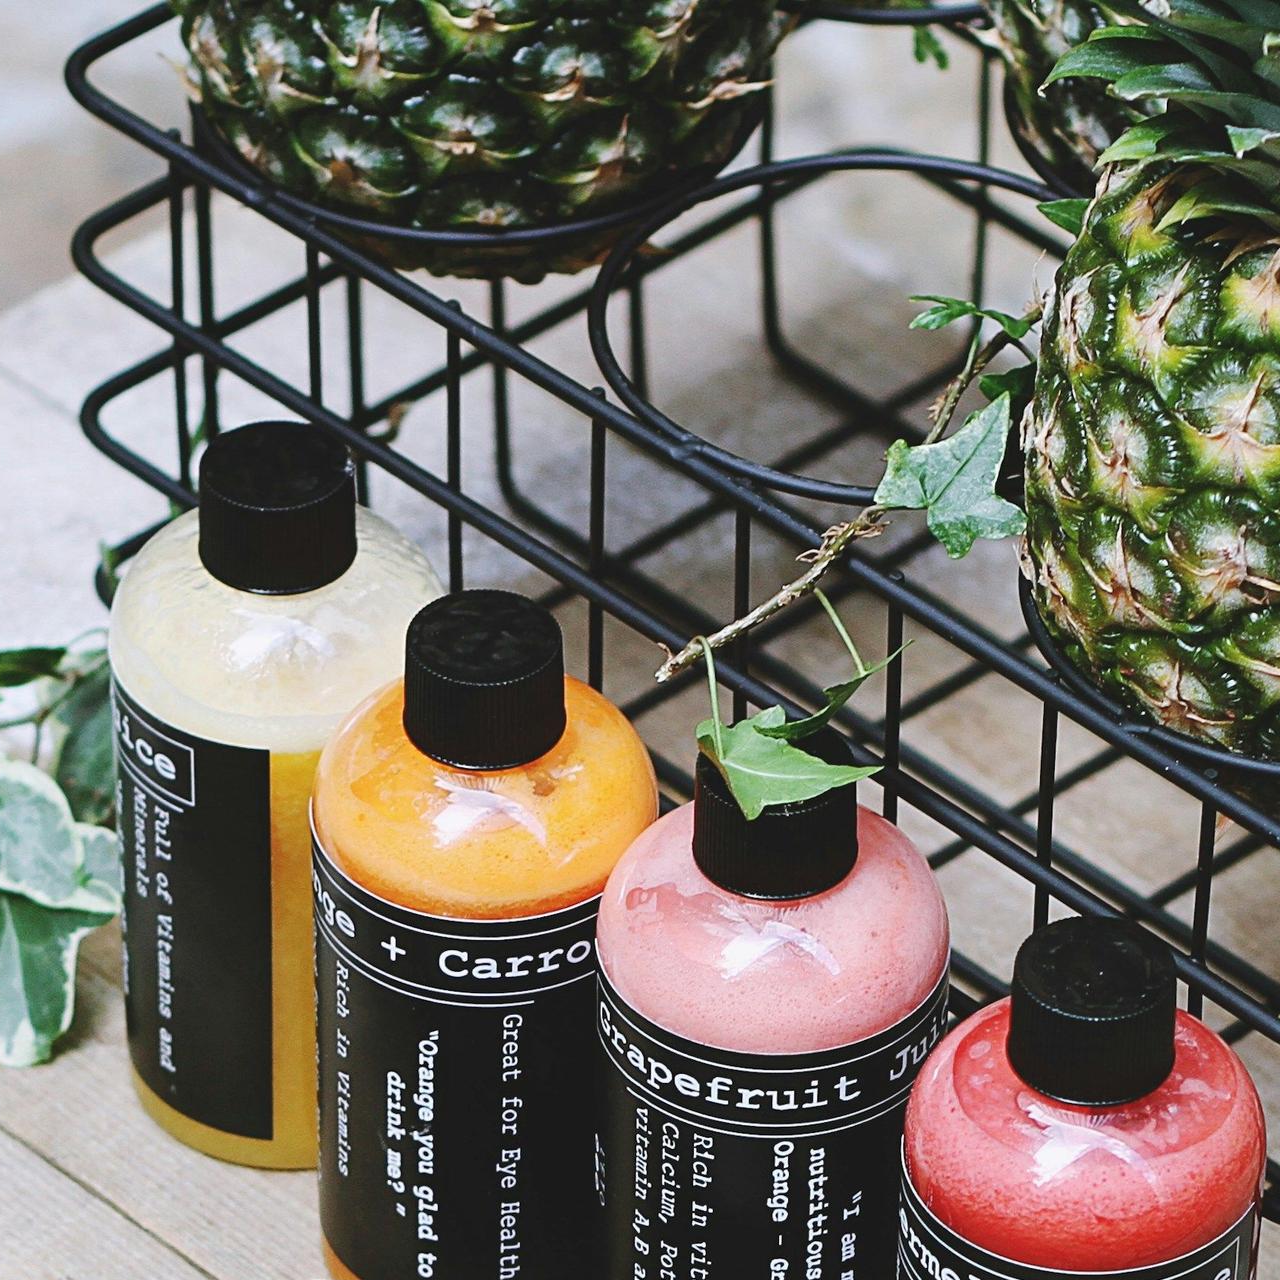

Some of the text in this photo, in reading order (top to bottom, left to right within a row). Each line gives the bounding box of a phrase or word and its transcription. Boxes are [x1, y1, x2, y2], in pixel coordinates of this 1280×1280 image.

[133, 785, 150, 898] Minerals
[154, 805, 177, 1073] Full of Vitamins and
[381, 936, 406, 962] +
[336, 959, 352, 1178] Rich in Vitamins
[599, 1001, 862, 1112] Grapefruit
[386, 1071, 406, 1141] drink
[496, 1013, 523, 1280] Great for Eye Health
[386, 1148, 406, 1194] me?
[412, 1029, 439, 1279] "Orange you glad to
[635, 1107, 652, 1201] vitamin
[658, 1122, 681, 1224] Calcium,
[692, 1132, 715, 1189] Rich
[767, 1140, 795, 1223] Orange
[632, 1208, 650, 1256] A,B
[691, 1200, 714, 1227] in
[806, 1147, 829, 1280] nutritious
[841, 1232, 857, 1262] am
